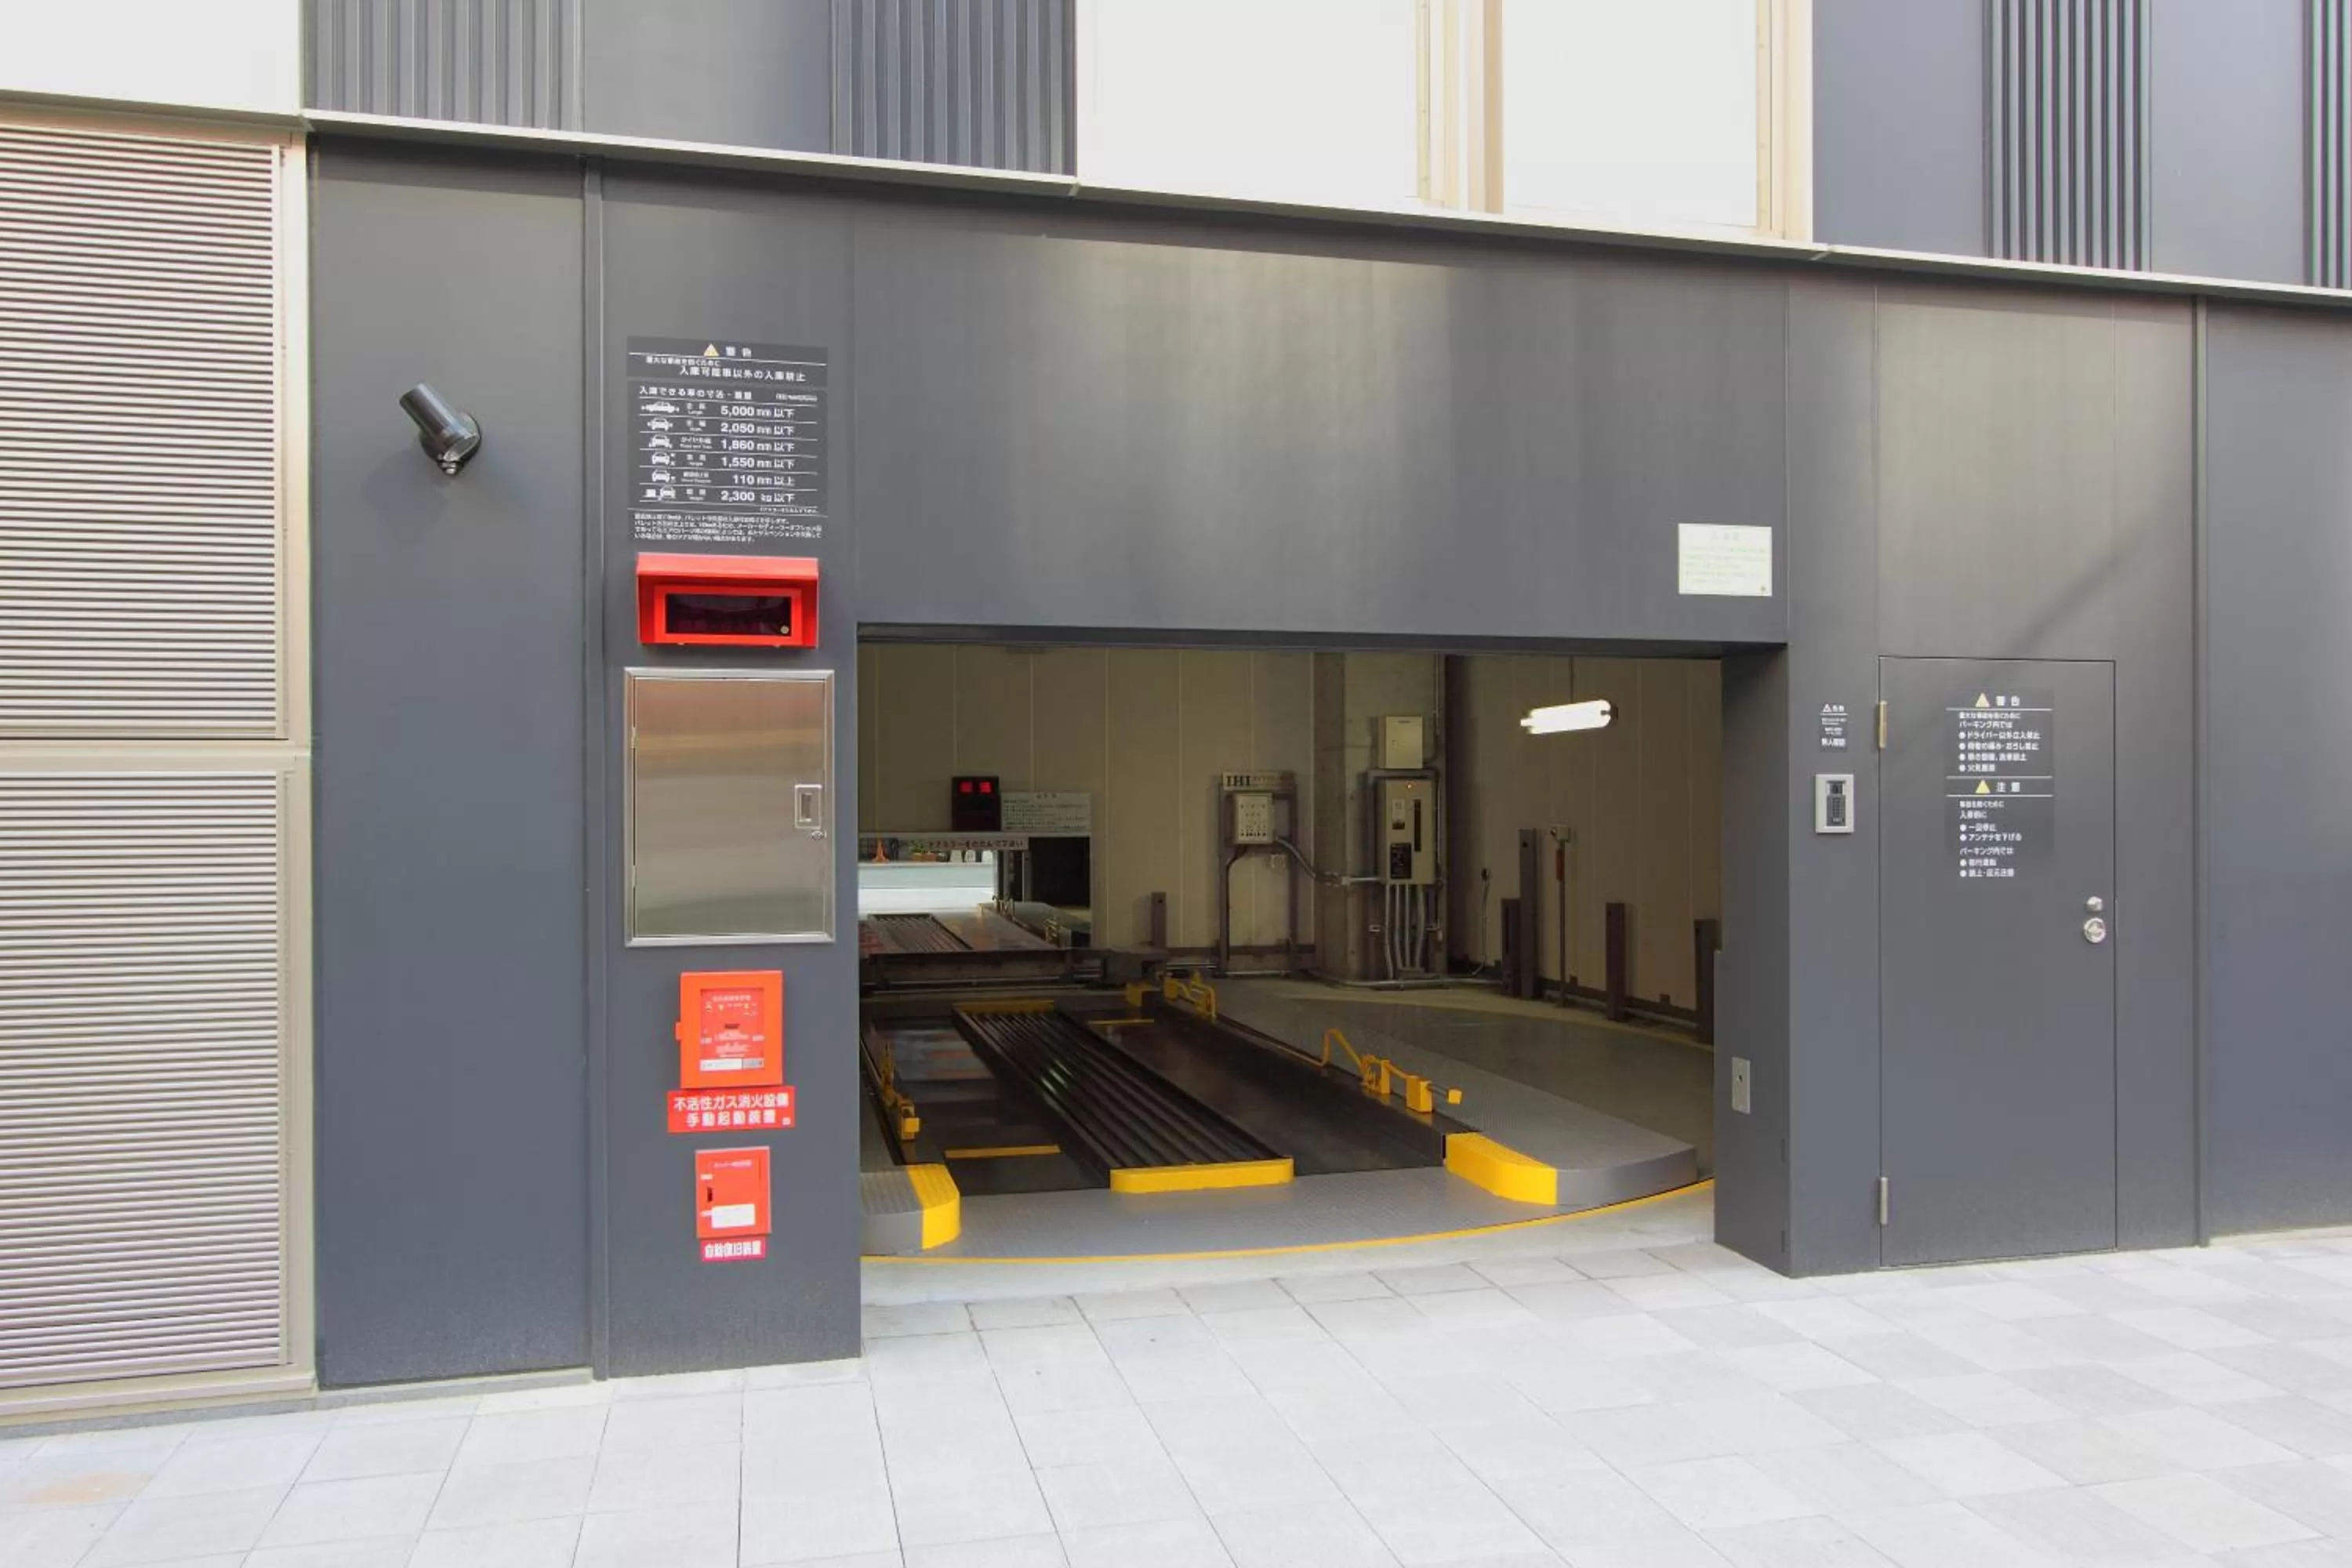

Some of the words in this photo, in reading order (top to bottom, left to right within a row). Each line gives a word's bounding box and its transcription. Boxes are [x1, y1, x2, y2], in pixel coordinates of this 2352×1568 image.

[720, 405, 754, 417] 5,000
[720, 423, 754, 434] 2,050
[720, 439, 754, 451] 1,860
[720, 457, 754, 468] 1,550
[733, 474, 754, 485] 110
[720, 490, 755, 503] 2,300
[673, 1092, 789, 1111] 不活性ガス消火設備
